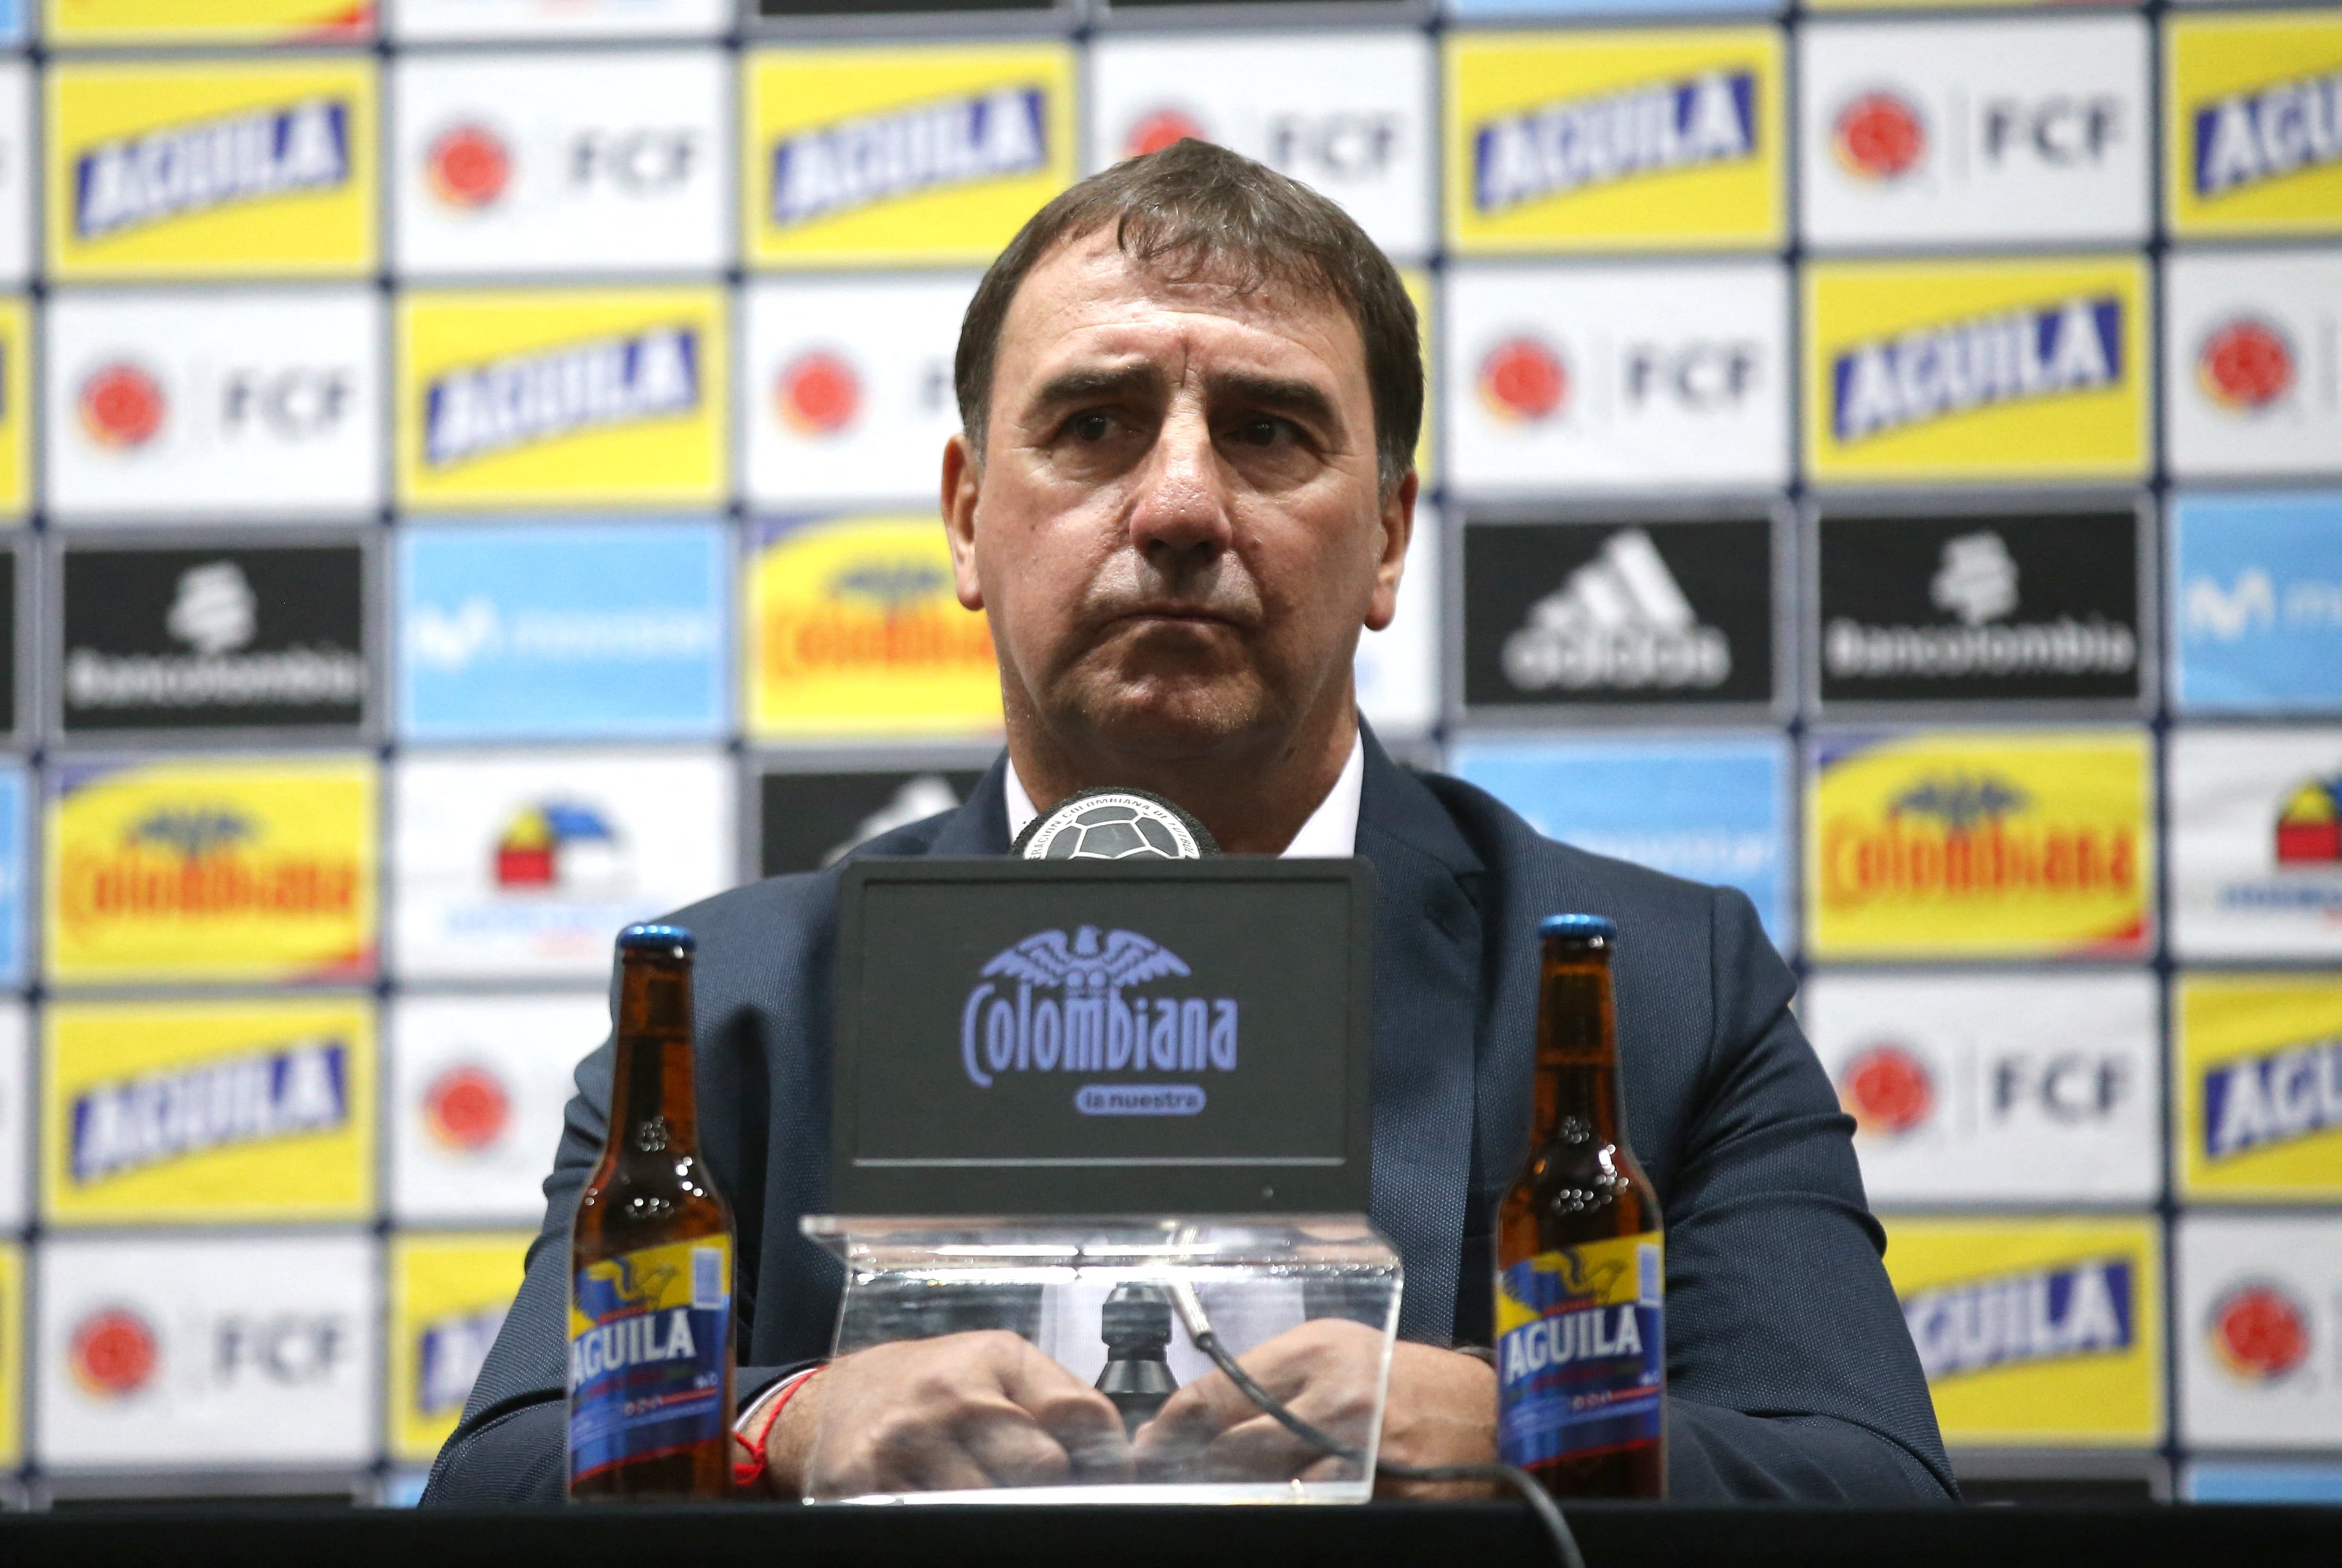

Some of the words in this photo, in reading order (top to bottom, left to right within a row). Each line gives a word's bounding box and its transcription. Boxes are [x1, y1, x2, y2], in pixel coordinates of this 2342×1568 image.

[1483, 71, 1749, 210] AGUILA
[1981, 96, 2125, 168] FCF
[2200, 74, 2342, 190] AGU
[1624, 342, 1764, 416] FCF
[1837, 298, 2113, 437] AGUILA
[1826, 617, 2136, 677] Bancolombia
[1062, 798, 1150, 818] COLOMBIANA
[961, 981, 1238, 1088] Colombiana
[1086, 1091, 1104, 1108] la
[1110, 1091, 1198, 1108] nuestra
[1991, 1051, 2138, 1127] FCF
[570, 1308, 696, 1391] AGUILA
[1504, 1304, 1643, 1386] AGUILA
[1908, 1262, 2123, 1381] GUILA
